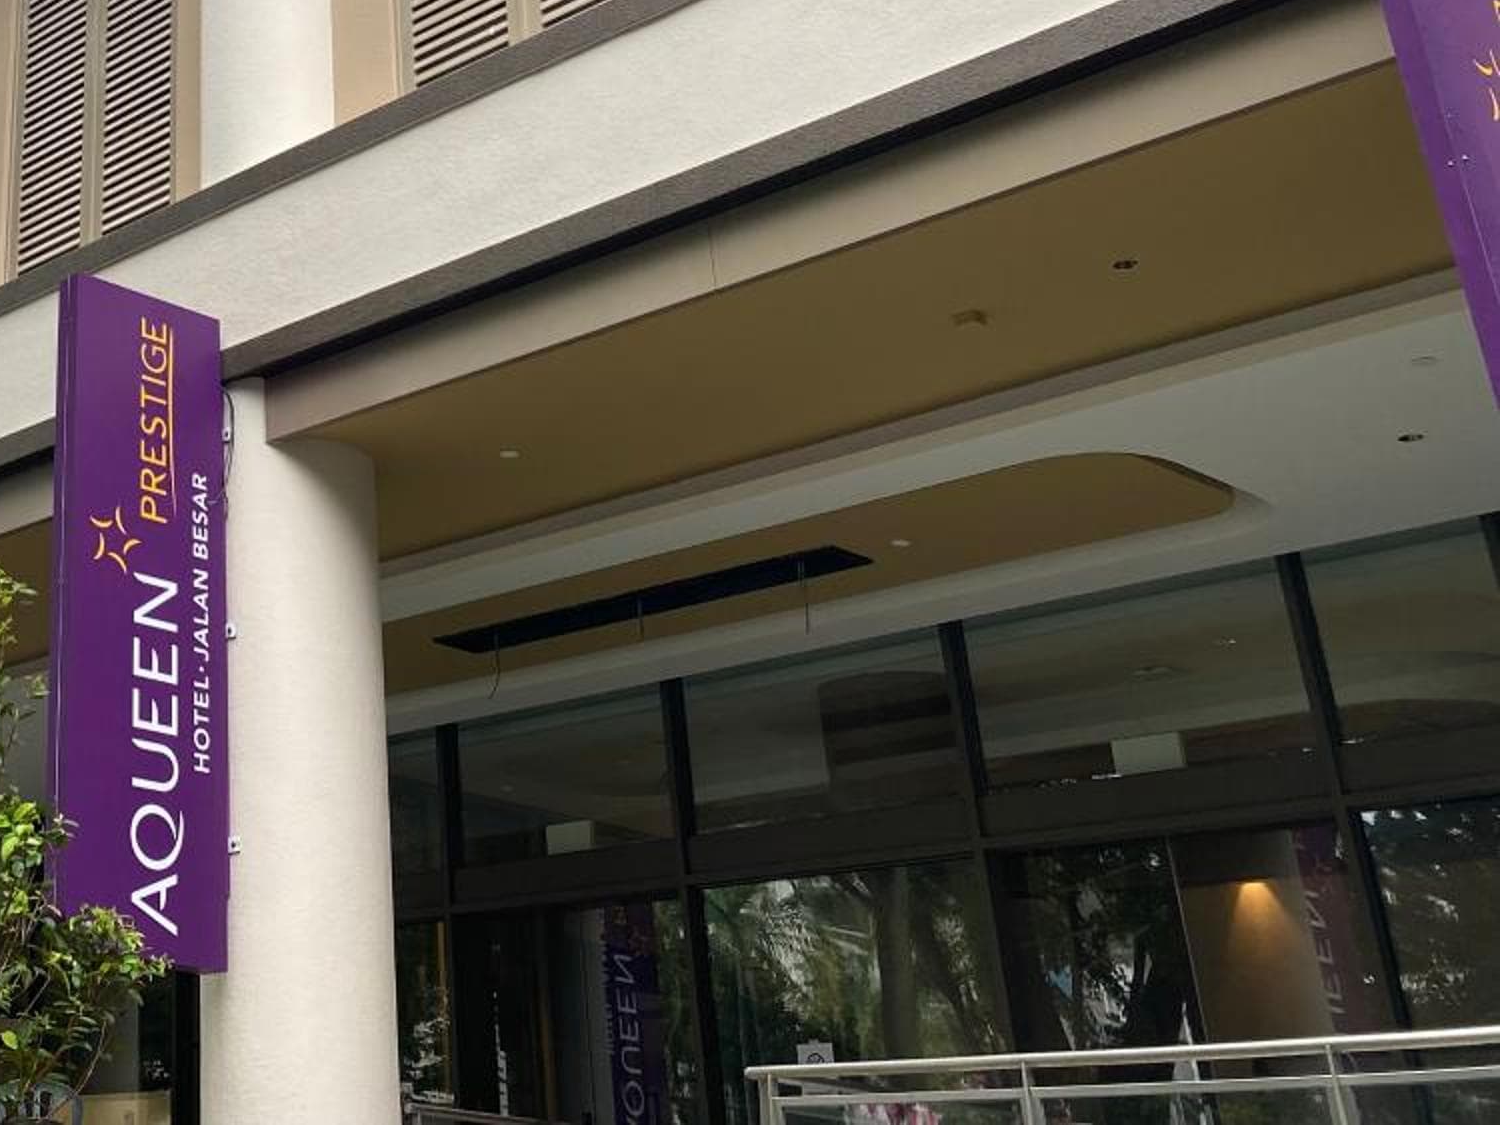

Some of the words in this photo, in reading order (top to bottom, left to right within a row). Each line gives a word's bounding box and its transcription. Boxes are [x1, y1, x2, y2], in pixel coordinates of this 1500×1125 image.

[140, 316, 171, 524] PRESTIGE
[191, 472, 209, 560] BESAR
[129, 571, 185, 936] AQUEEN
